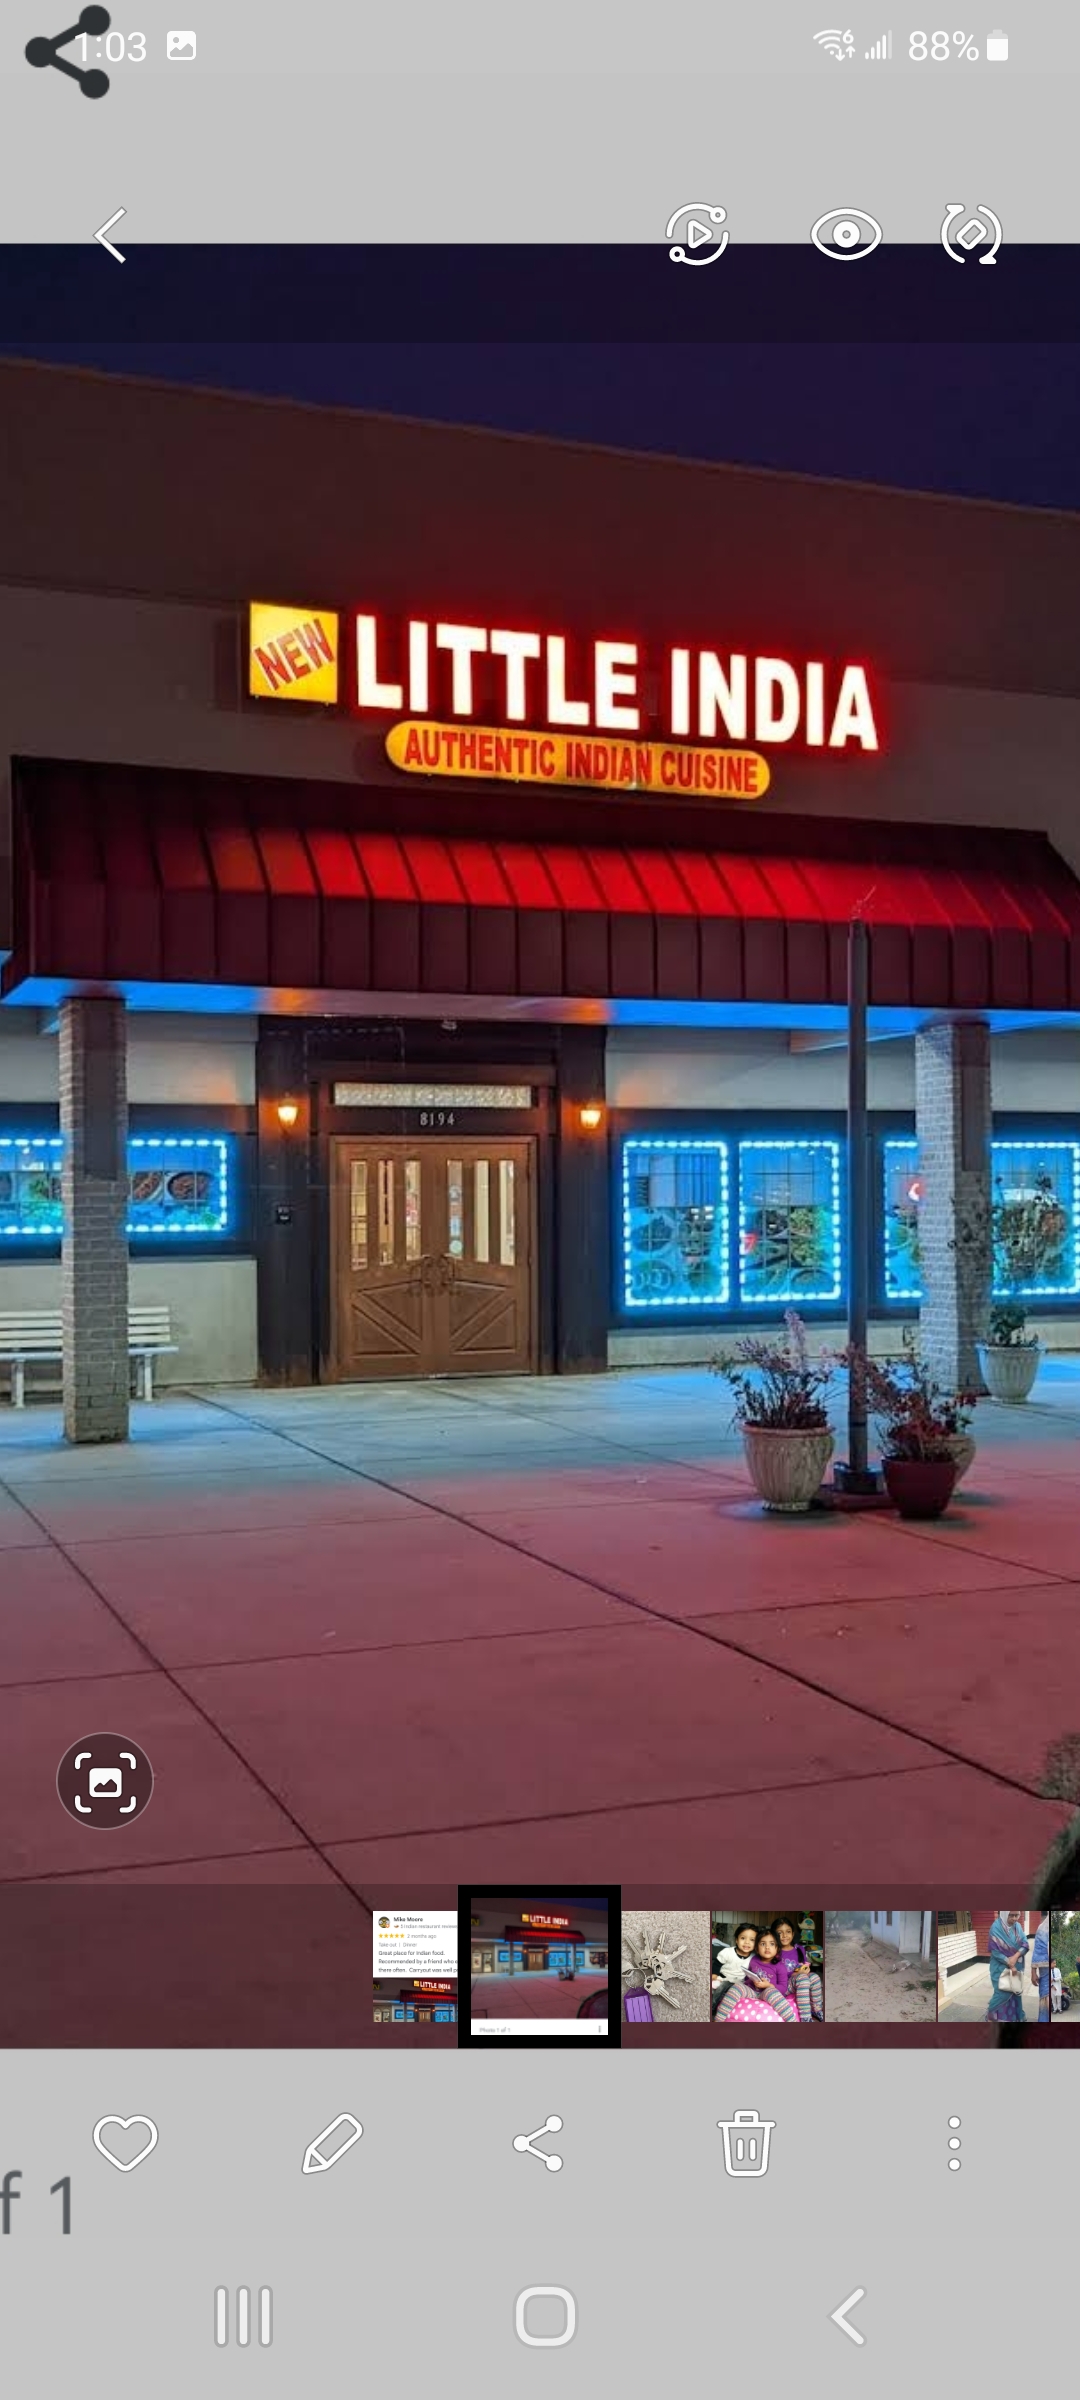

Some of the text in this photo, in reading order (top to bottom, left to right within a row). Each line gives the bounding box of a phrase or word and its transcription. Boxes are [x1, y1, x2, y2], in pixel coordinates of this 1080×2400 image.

[254, 618, 333, 690] NEW
[356, 615, 879, 750] LITTLE INDIA
[403, 729, 759, 793] AUTHENTIC INDIAN CUISINE
[419, 1112, 455, 1126] 8194
